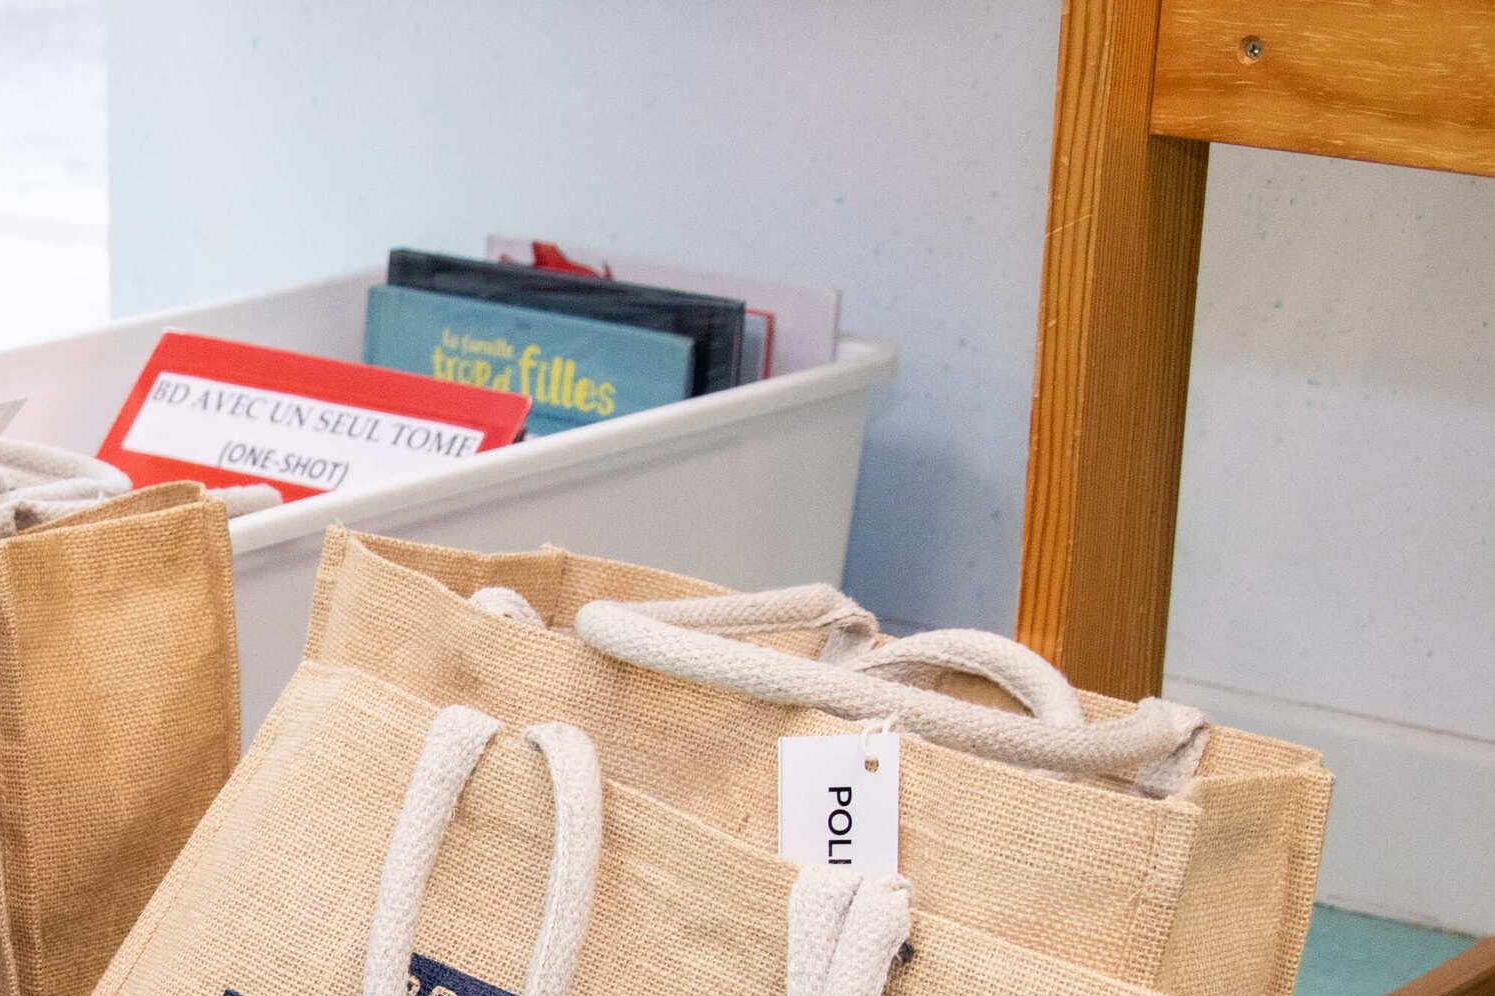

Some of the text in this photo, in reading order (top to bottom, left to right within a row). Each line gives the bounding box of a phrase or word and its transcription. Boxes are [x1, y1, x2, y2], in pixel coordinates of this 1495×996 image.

[153, 379, 190, 404] BD
[193, 390, 267, 420] AVEC
[269, 401, 314, 430] UN
[310, 407, 381, 443] SEUL
[520, 343, 617, 416] filles
[218, 439, 350, 486] (ONE-SHOT)
